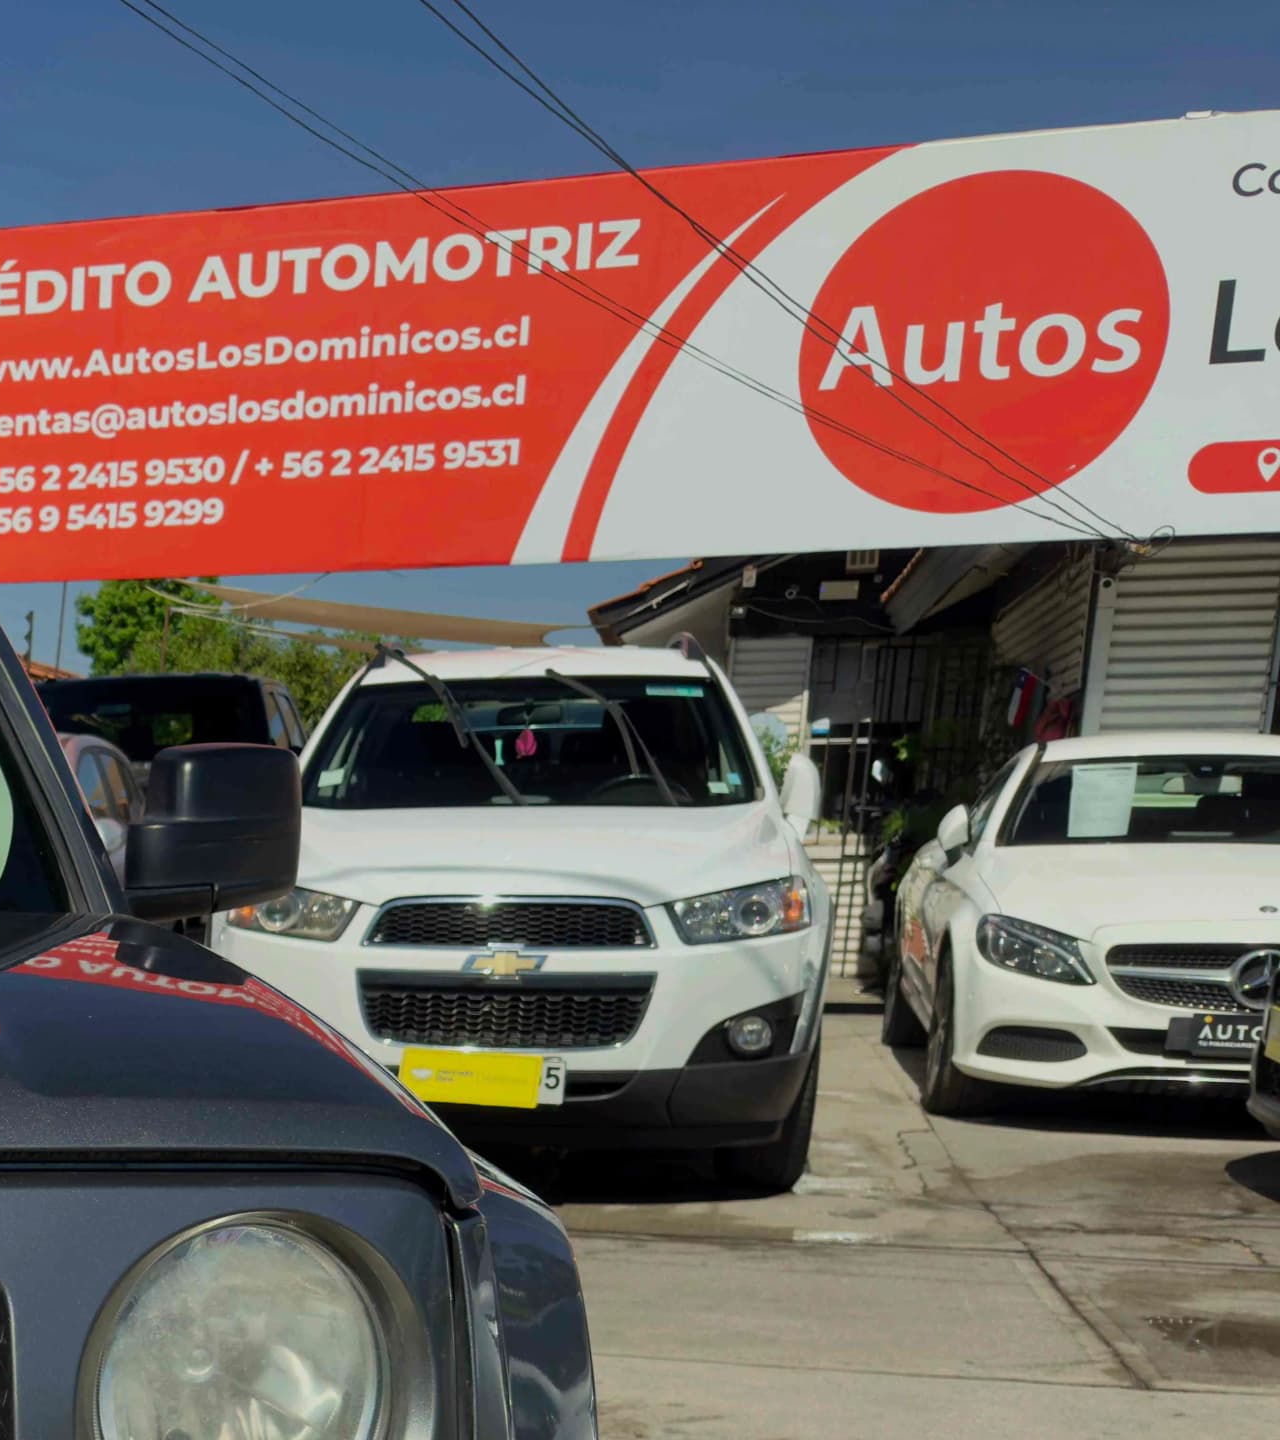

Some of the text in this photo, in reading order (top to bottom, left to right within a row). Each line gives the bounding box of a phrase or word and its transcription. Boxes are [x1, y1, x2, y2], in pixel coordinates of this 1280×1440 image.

[187, 218, 642, 304] AUTOMOTRIZ
[818, 301, 1143, 391] Autos
[1208, 279, 1280, 365] L
[41, 464, 62, 492] 2
[67, 461, 138, 490] 2415
[144, 456, 226, 487] 9530
[281, 450, 324, 480] 56
[331, 448, 353, 476] 2
[358, 443, 436, 475] 2415
[443, 438, 521, 470] 9531
[39, 505, 61, 533] 9
[66, 501, 138, 531] 5415
[144, 497, 225, 528] 9299
[544, 1067, 561, 1090] 5
